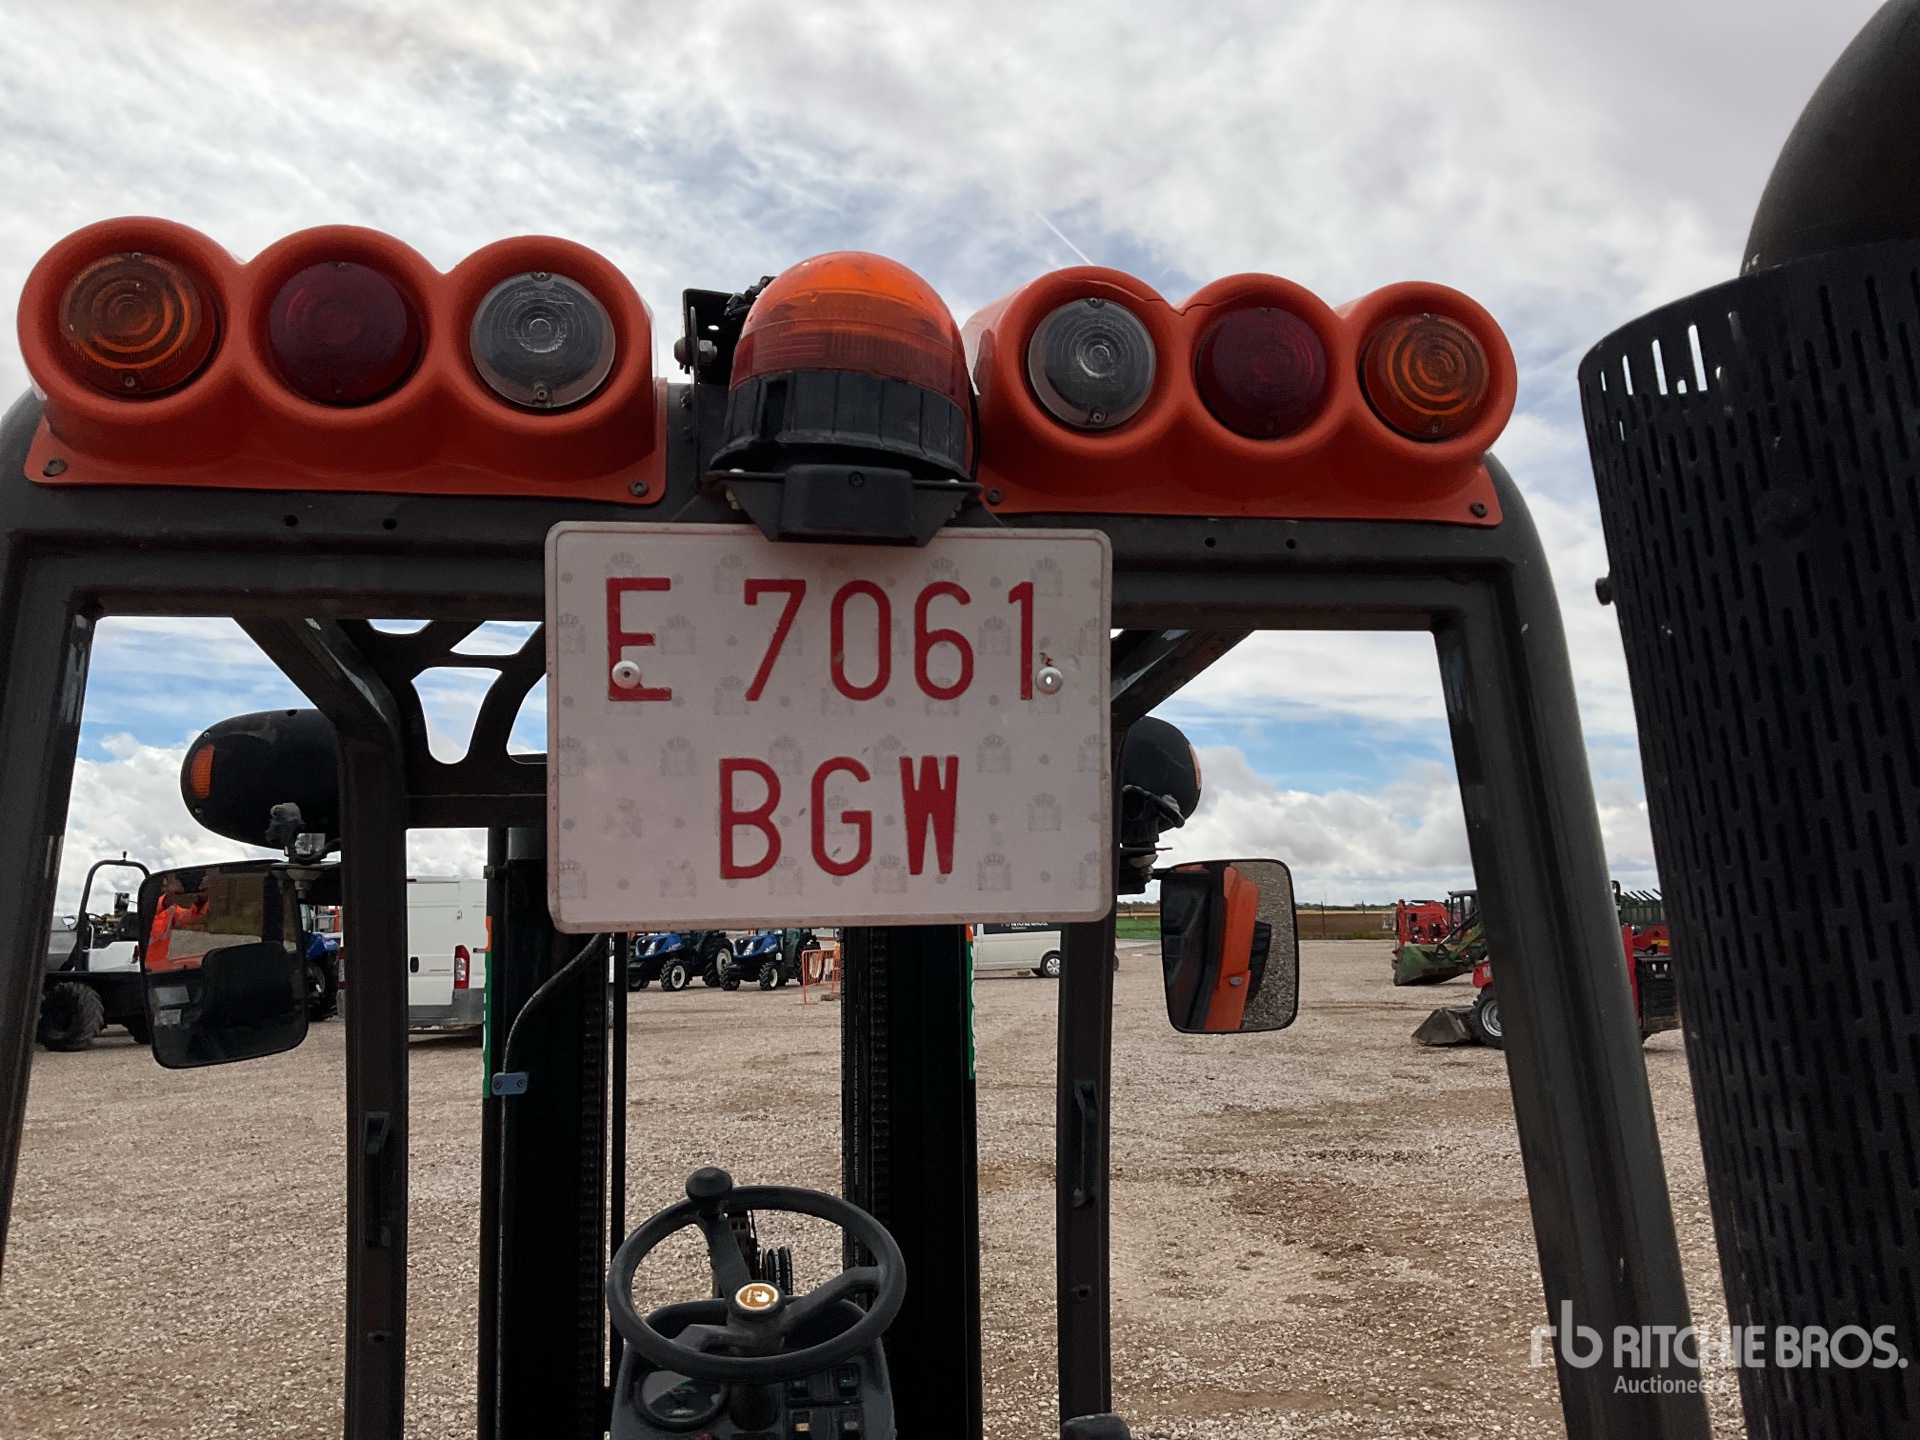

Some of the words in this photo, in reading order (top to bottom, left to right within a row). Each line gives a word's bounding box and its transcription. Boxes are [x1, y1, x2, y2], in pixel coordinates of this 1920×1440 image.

[605, 577, 672, 701] E
[743, 578, 1035, 701] 7061
[718, 754, 960, 880] BGW
